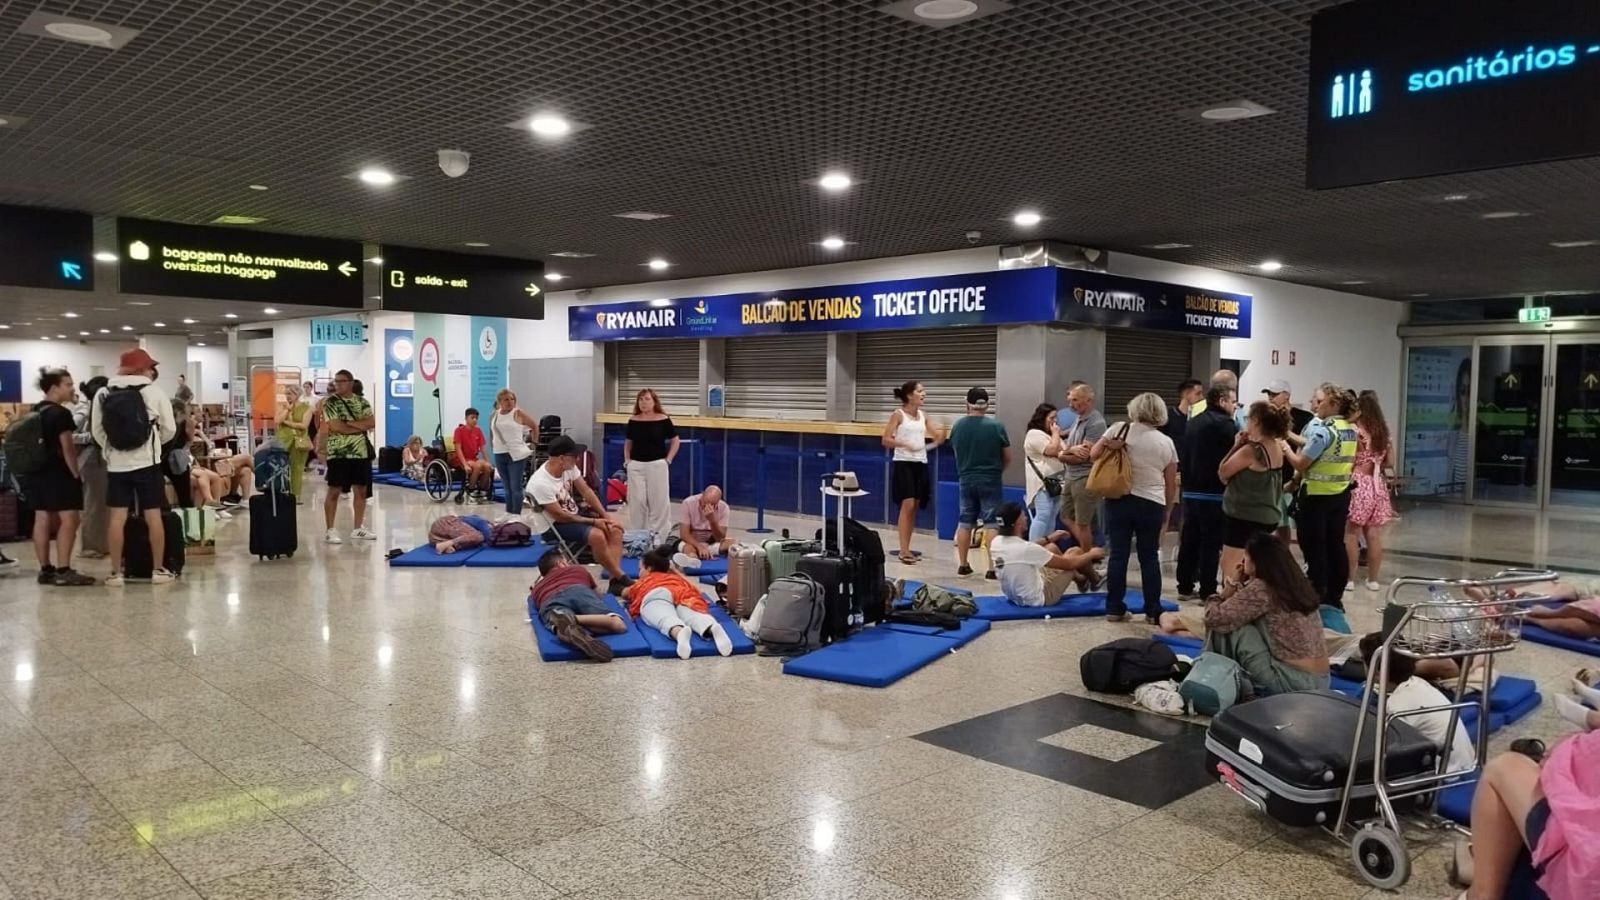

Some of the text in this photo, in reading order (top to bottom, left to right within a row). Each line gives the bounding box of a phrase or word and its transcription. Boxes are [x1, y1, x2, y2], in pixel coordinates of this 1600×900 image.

[1408, 45, 1576, 91] sanitários
[162, 246, 329, 271] bagagem não normalizada
[163, 261, 276, 279] oversized baggage
[450, 278, 468, 288] exit
[741, 286, 987, 325] BALCÃO DE VENDAS TICKET OFFICE
[1084, 289, 1146, 313] RYANAIR
[1185, 294, 1240, 315] BALCÃO DE VENDAS
[606, 309, 676, 330] RYANAIR
[1185, 313, 1239, 330] TICKET OFFICE
